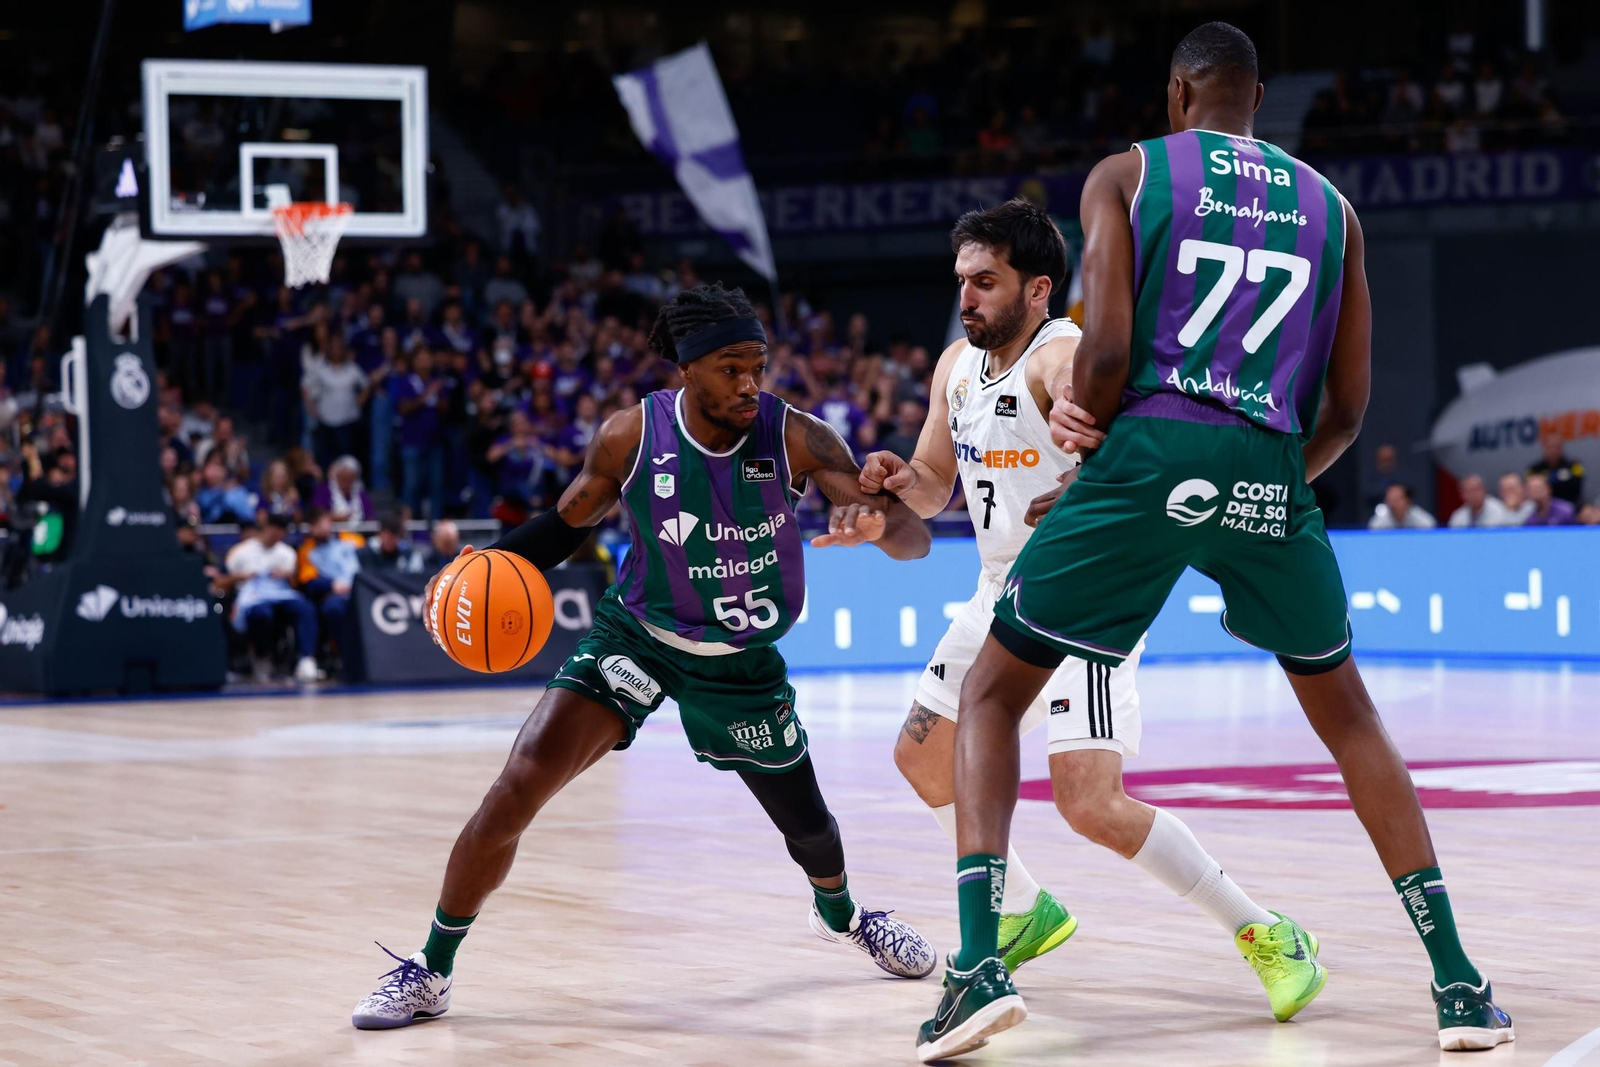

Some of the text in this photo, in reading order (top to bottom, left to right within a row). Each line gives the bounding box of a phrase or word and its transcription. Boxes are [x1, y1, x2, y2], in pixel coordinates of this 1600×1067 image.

[1209, 149, 1291, 188] Sima
[1176, 238, 1312, 354] 77
[1165, 366, 1280, 413] Andalucía
[745, 465, 759, 474] liga
[954, 440, 1041, 469] UTOHERO
[746, 471, 774, 479] endesa
[976, 479, 997, 530] 7
[1232, 481, 1289, 503] COSTA
[1225, 500, 1261, 519] DEL
[704, 512, 787, 542] Unicaja
[120, 594, 209, 624] Unicaja
[456, 595, 473, 646] EVO
[712, 584, 780, 632] 55
[1404, 885, 1436, 936] UNICAJA
[1454, 1001, 1464, 1010] 24
